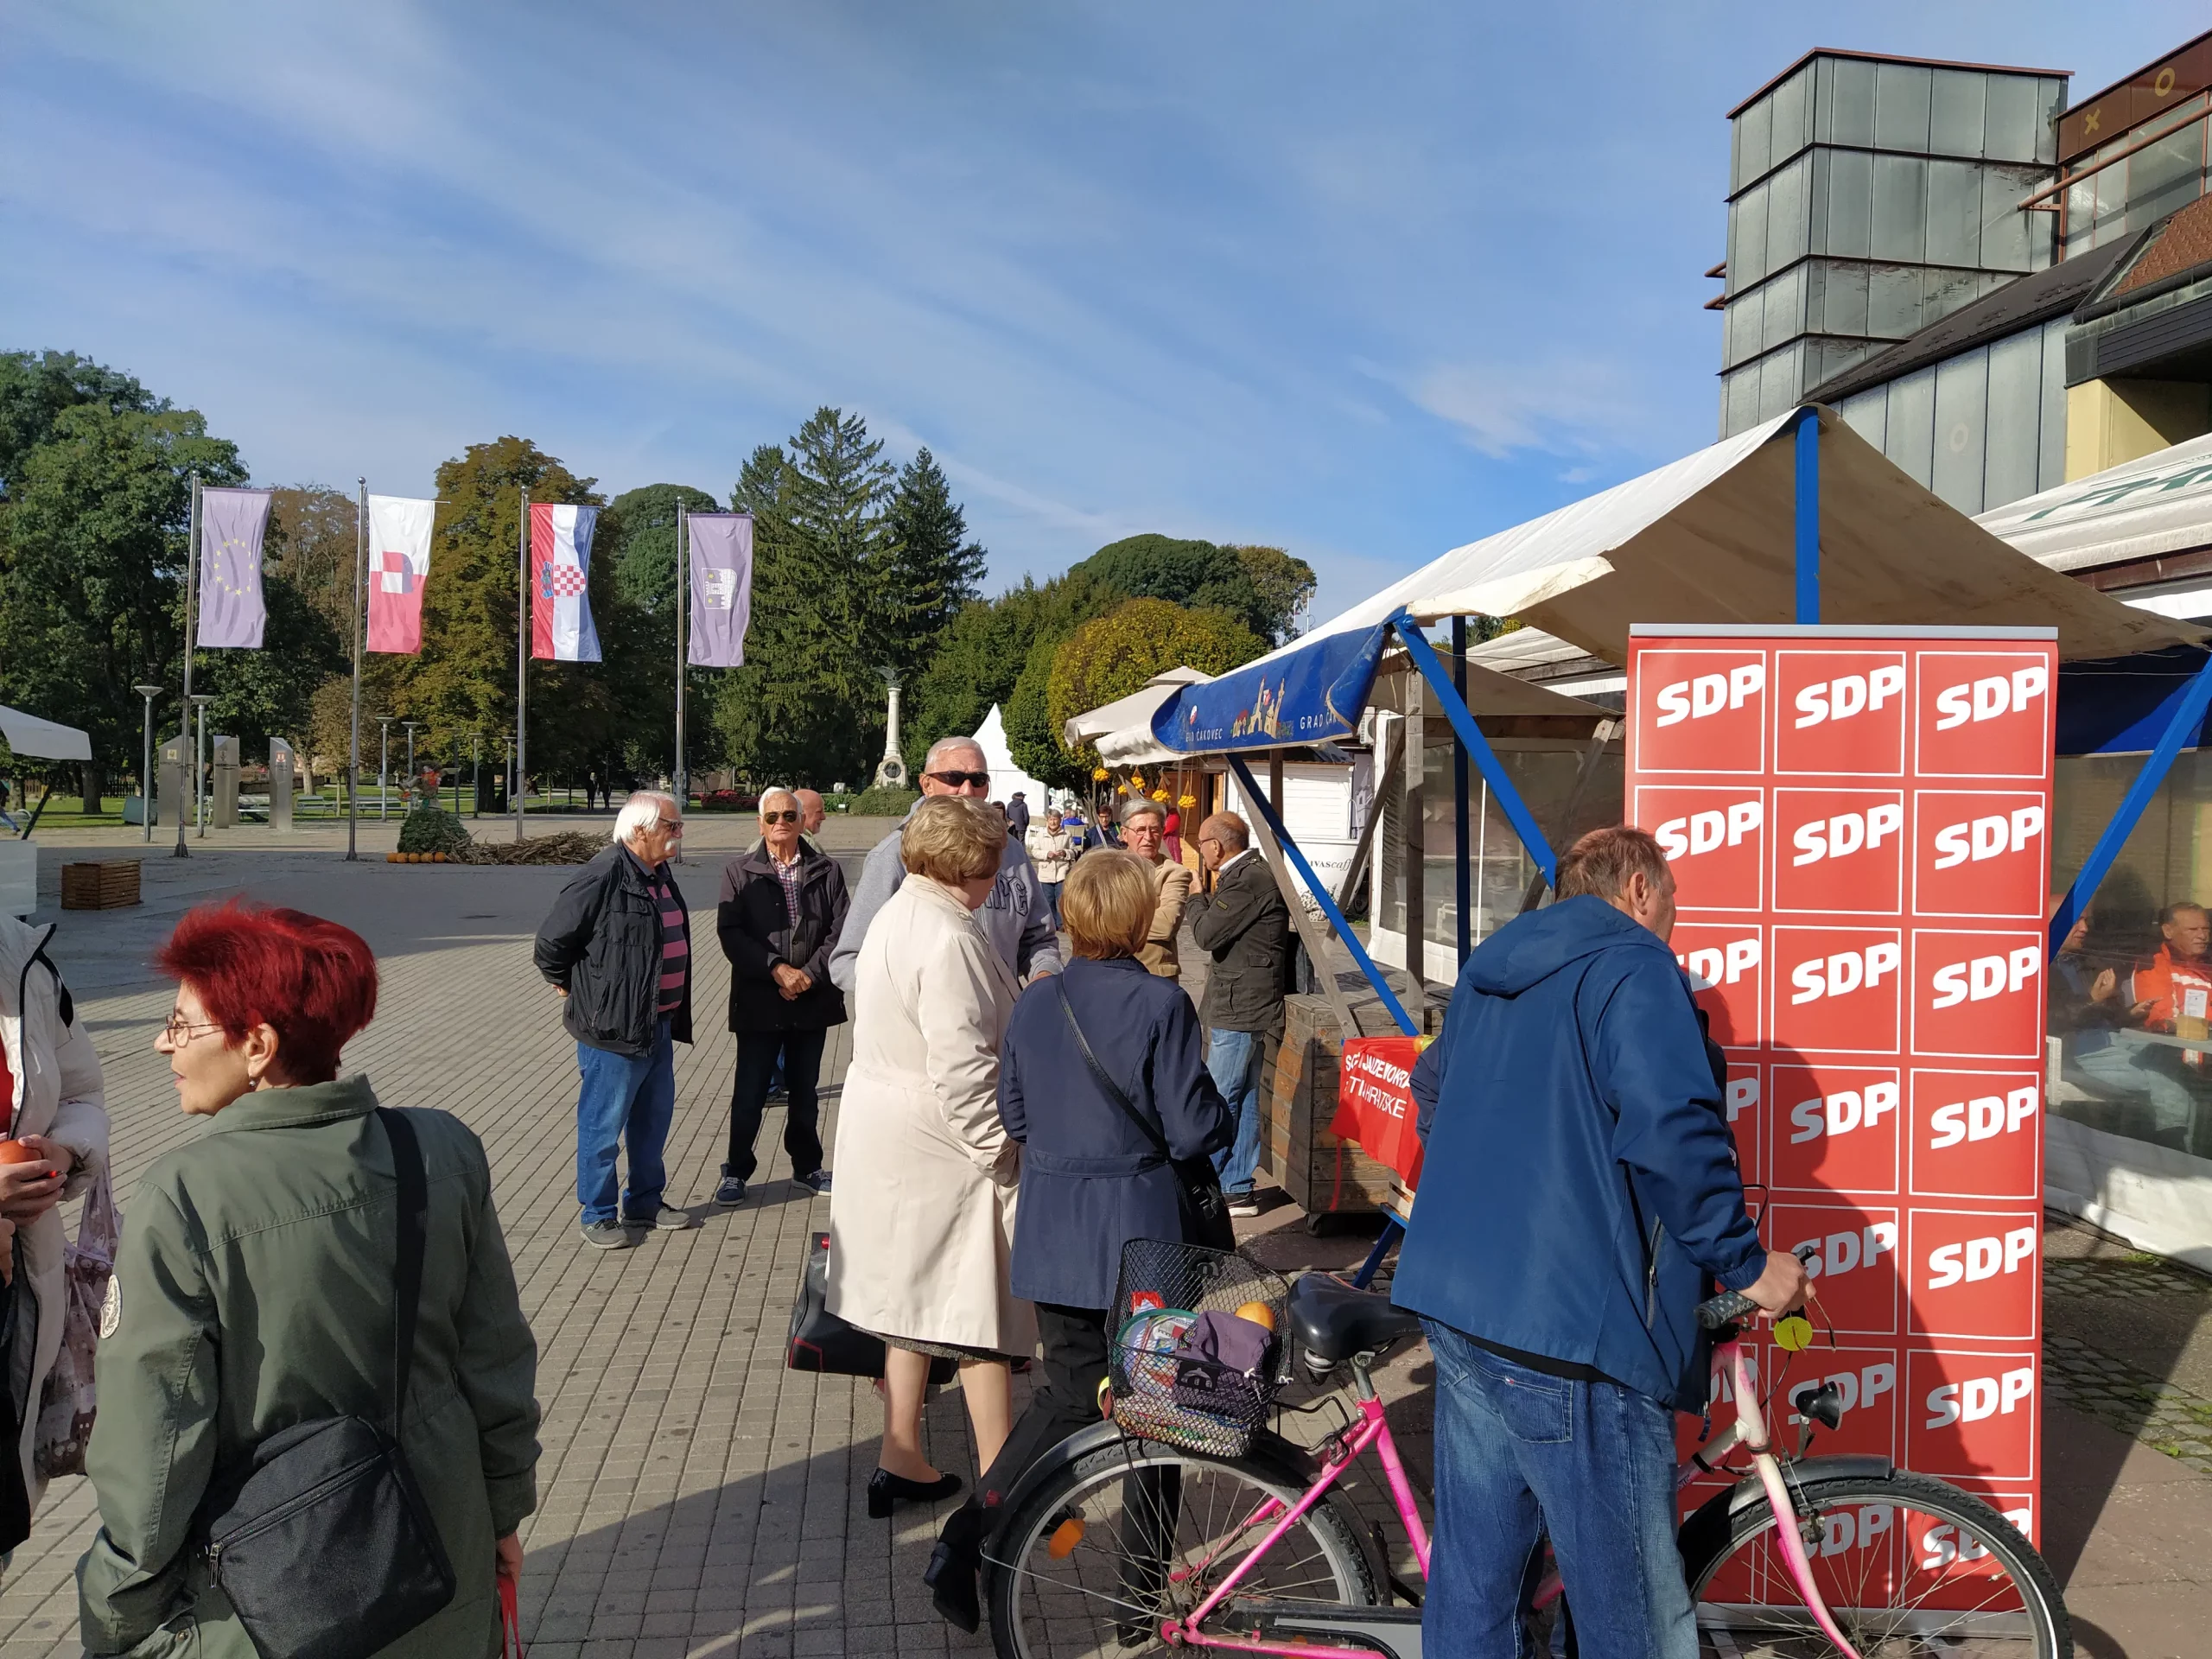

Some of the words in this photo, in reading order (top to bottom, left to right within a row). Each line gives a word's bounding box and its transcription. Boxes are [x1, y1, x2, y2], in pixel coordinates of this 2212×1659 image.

[1300, 714, 1324, 729] GRAD
[1657, 664, 1764, 728] SDP
[1795, 665, 1904, 729] SDP
[1936, 666, 2046, 731] SDP
[1654, 801, 1763, 862] SDP
[1793, 804, 1901, 868] SDP
[1935, 806, 2044, 870] SDP
[1675, 938, 1761, 993] DP
[1791, 943, 1899, 1006] SDP
[1932, 946, 2040, 1009] SDP
[1790, 1081, 1897, 1145] SDP
[1930, 1085, 2037, 1150] SDP
[1792, 1222, 1897, 1279] SDP
[1928, 1226, 2035, 1290] SDP
[1925, 1367, 2033, 1430] SDP
